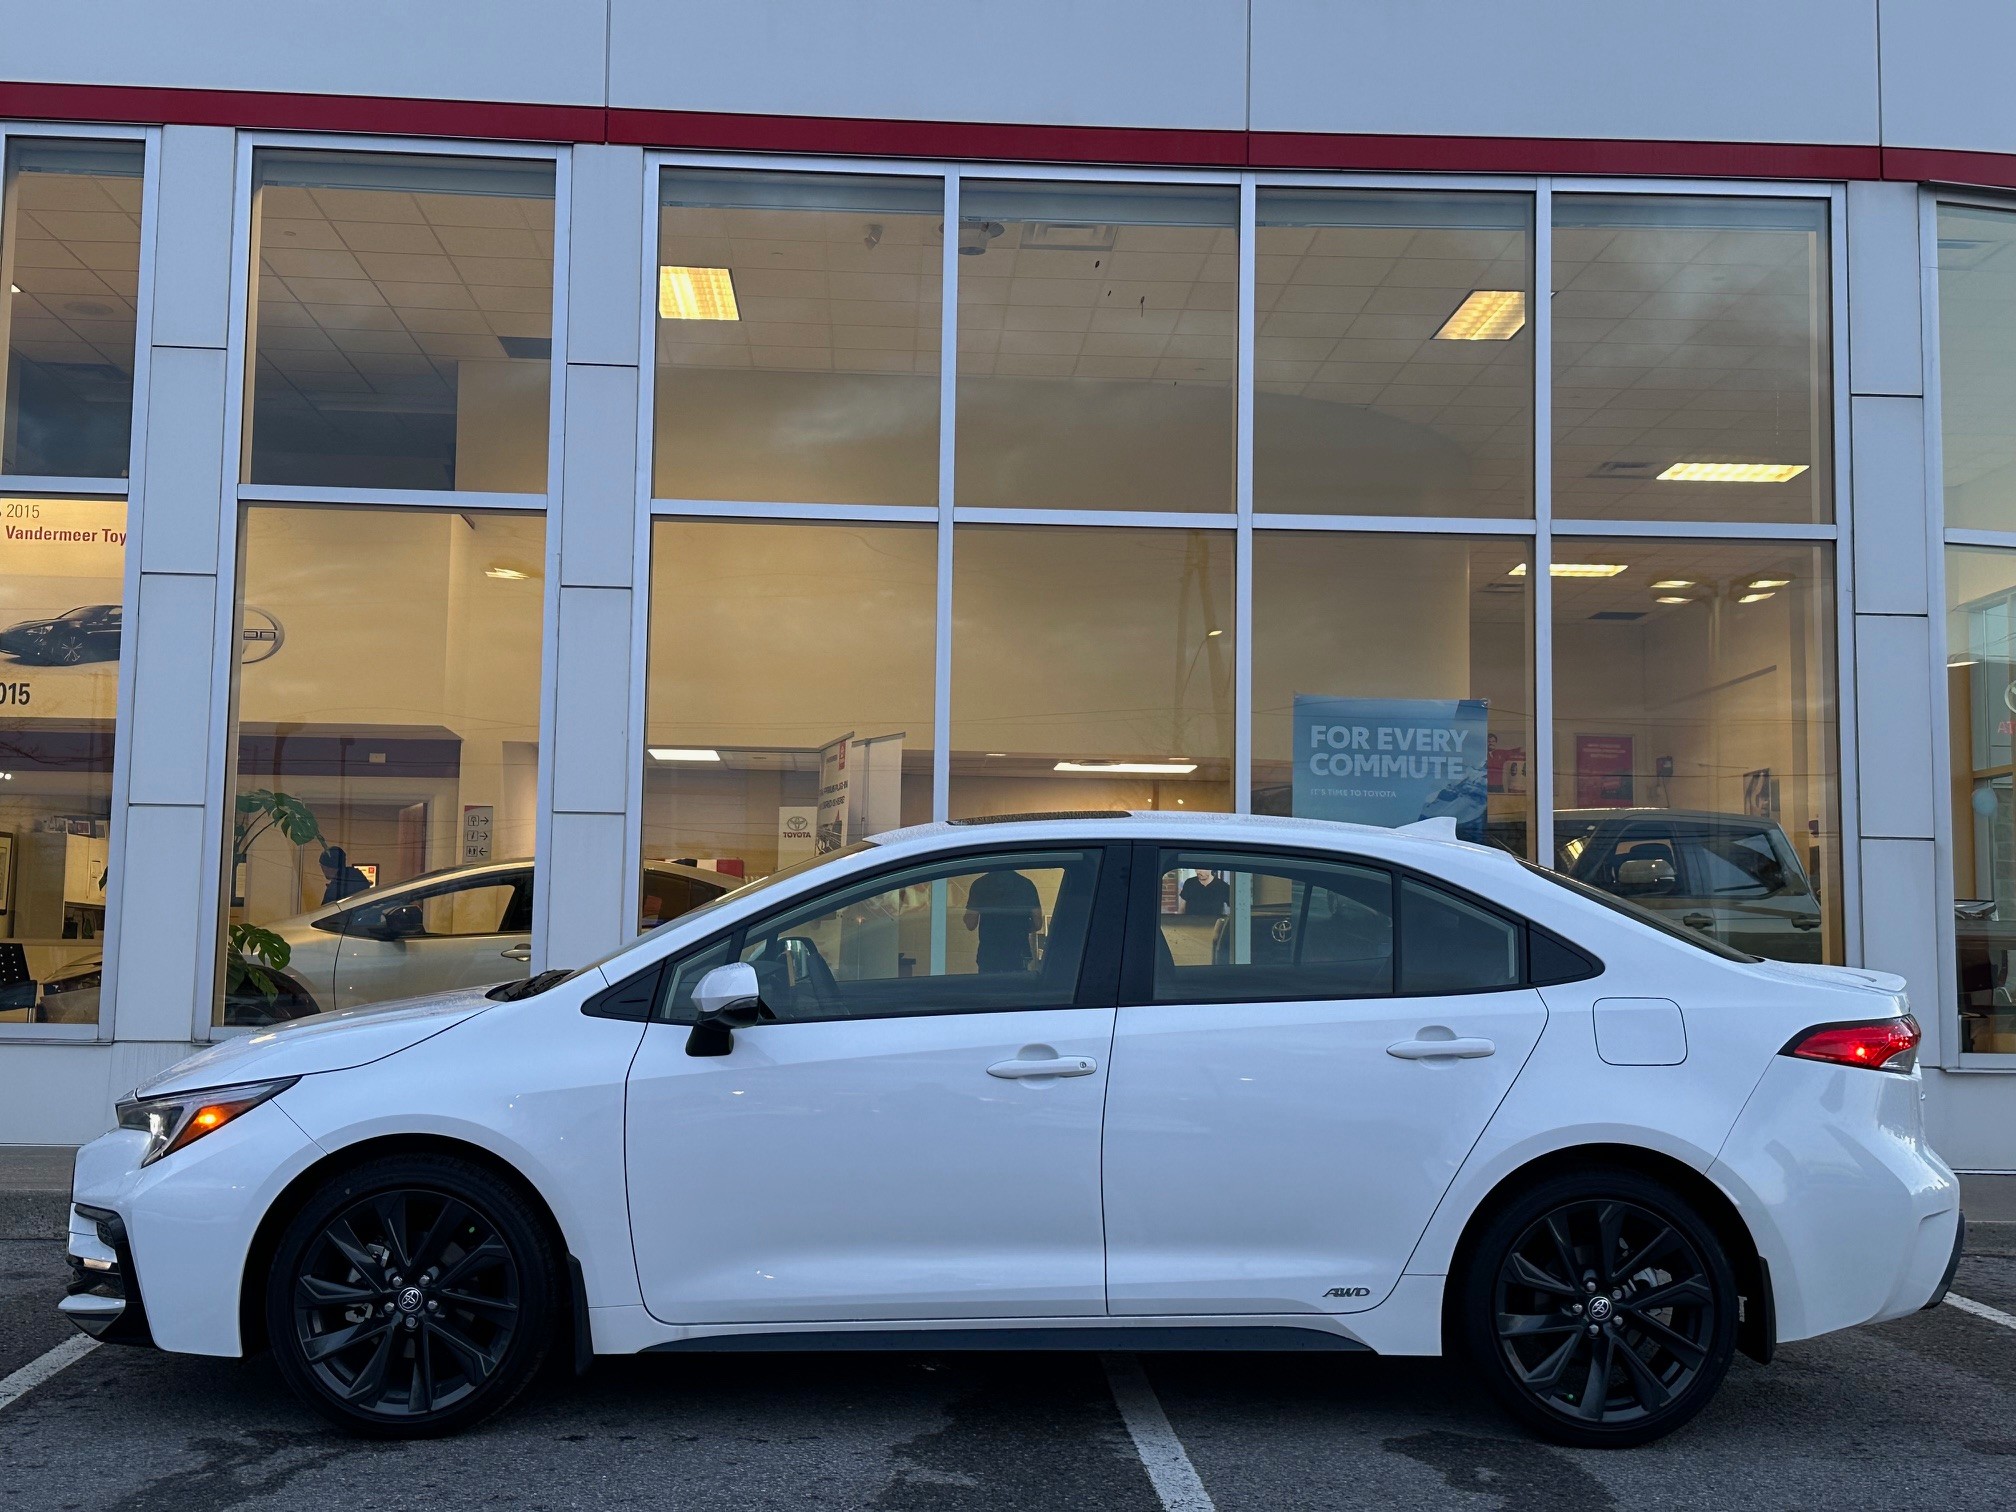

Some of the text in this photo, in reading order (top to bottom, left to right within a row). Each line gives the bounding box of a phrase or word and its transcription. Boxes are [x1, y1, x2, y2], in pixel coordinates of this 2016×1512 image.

[6, 503, 40, 519] 2015
[6, 525, 98, 543] Vandermeer
[1310, 725, 1468, 753] FOR EVERY
[1309, 752, 1465, 780] COMMUTE
[1328, 788, 1348, 797] TIME
[1350, 789, 1361, 797] TO
[1362, 790, 1397, 798] TOYOTA
[783, 831, 811, 839] TOYOTA
[1322, 1287, 1370, 1298] AWD
